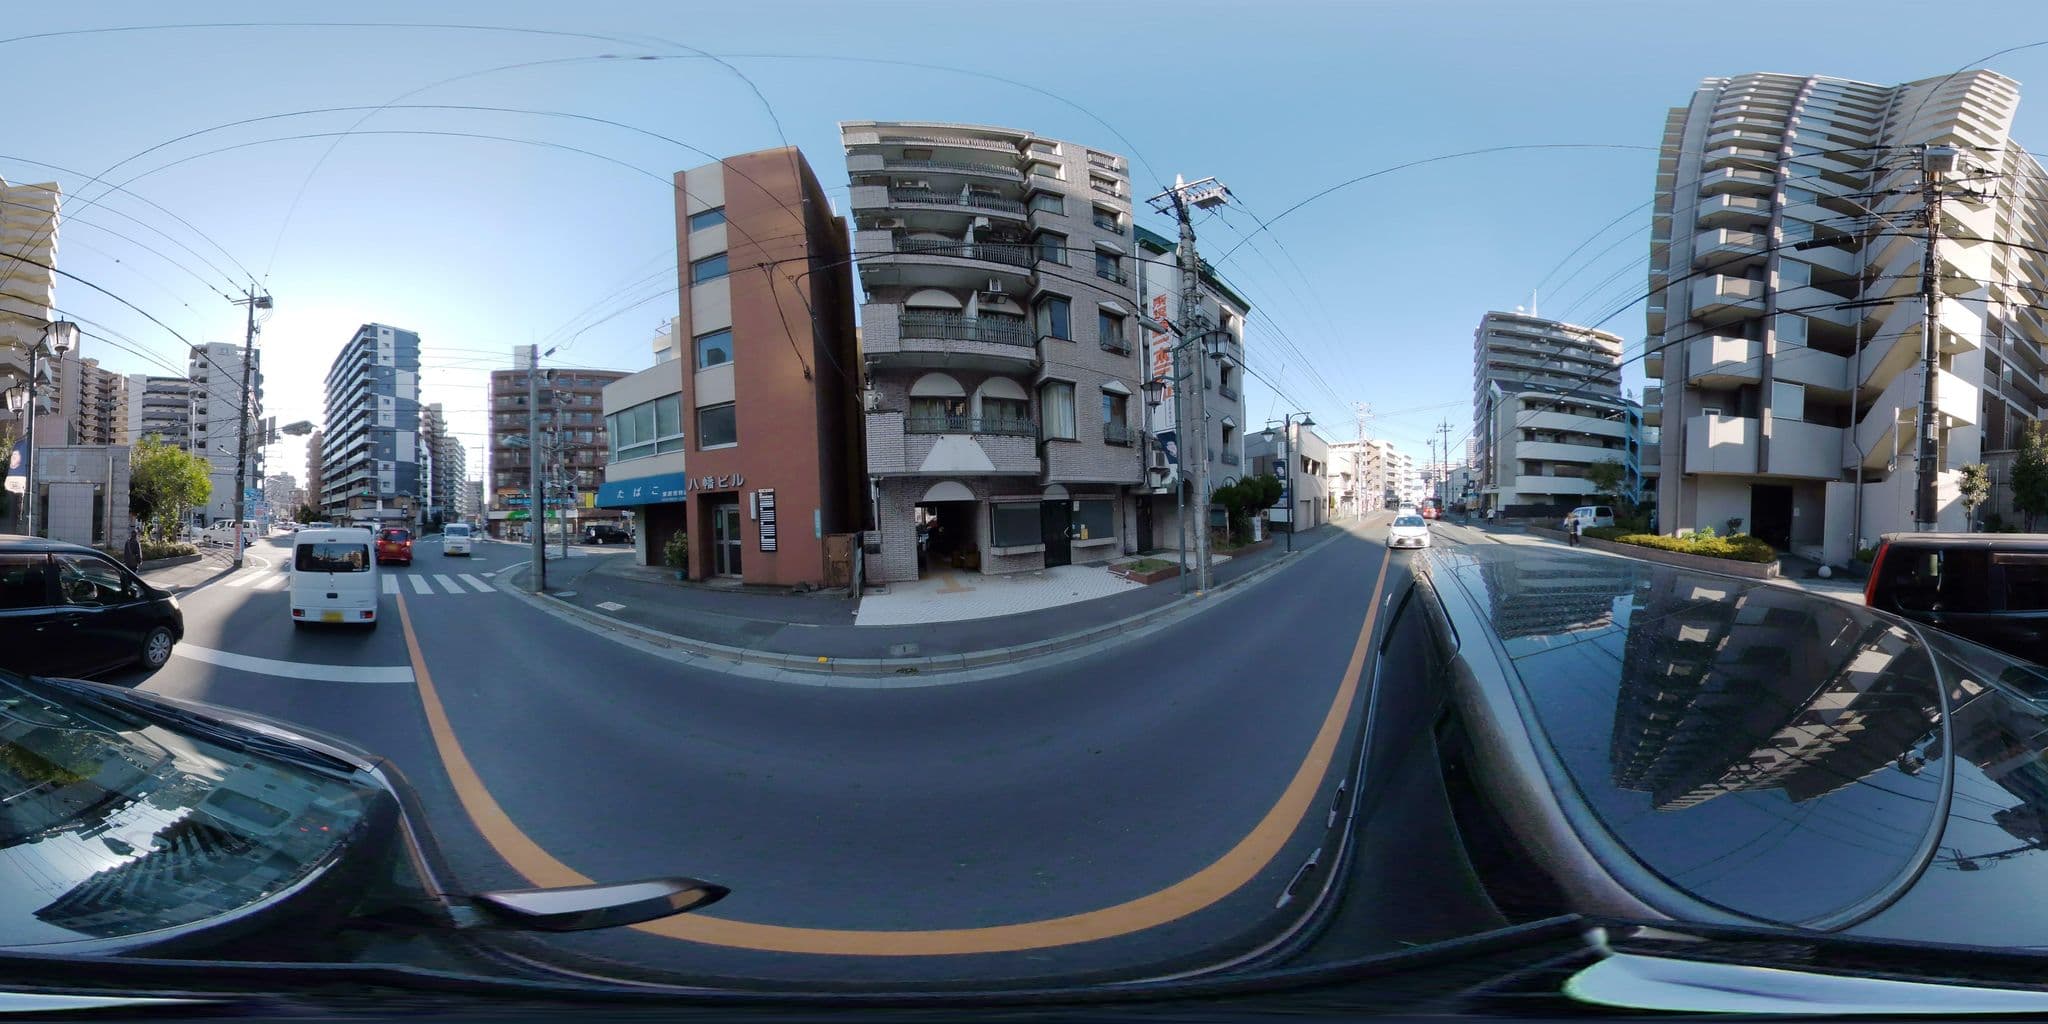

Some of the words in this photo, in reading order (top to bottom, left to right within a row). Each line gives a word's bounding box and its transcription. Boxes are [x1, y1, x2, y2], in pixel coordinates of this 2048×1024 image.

[688, 473, 744, 491] 八幡ビル
[616, 486, 659, 499] たばこ
